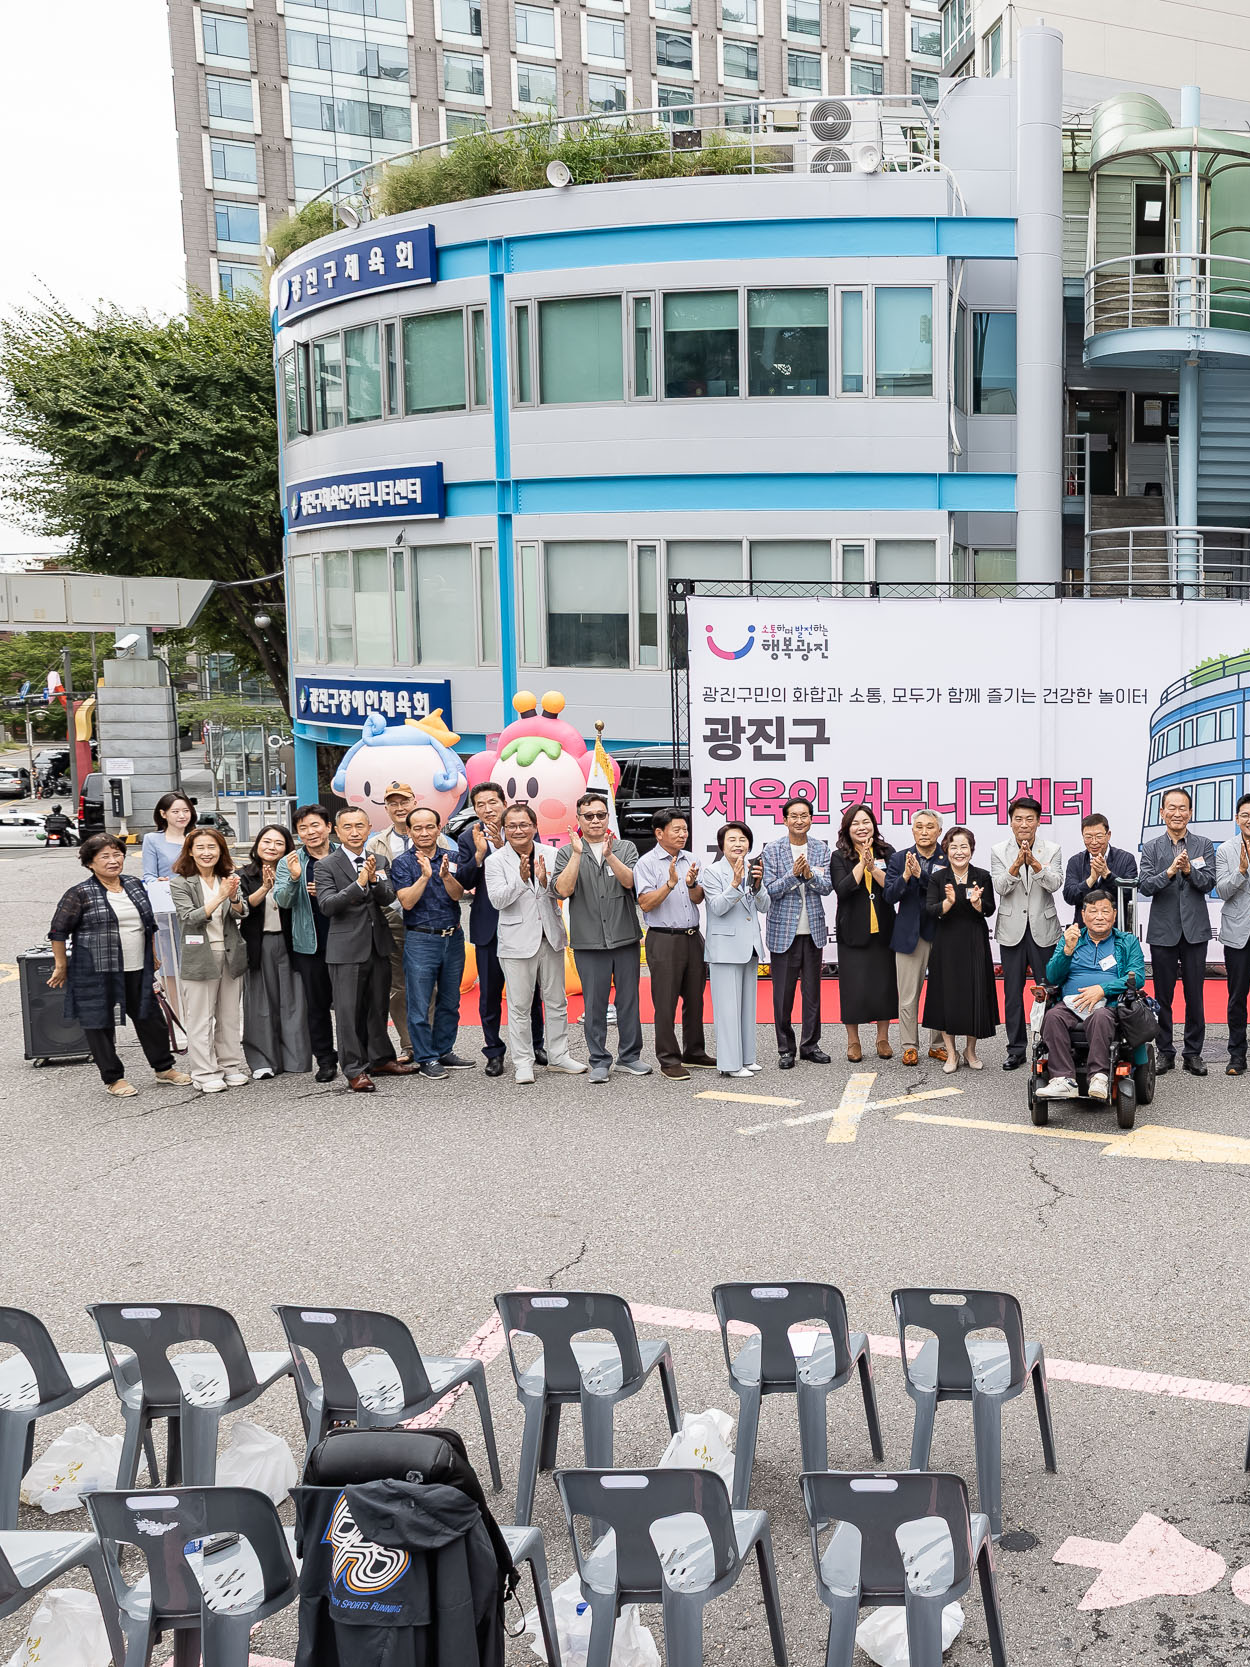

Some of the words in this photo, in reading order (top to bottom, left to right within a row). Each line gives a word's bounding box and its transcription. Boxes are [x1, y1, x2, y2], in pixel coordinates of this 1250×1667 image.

[291, 241, 414, 302] 광진구체육회
[300, 478, 422, 516] 광진구체육인커뮤니티센터
[761, 624, 793, 638] 소통하며
[795, 624, 829, 639] 발전하는
[761, 637, 829, 661] 행복광진
[309, 687, 430, 718] 광진구장애인체육회
[702, 686, 787, 703] 광진구민의
[792, 686, 843, 703] 화합과
[849, 687, 886, 704] 소통,
[892, 687, 942, 703] 모두가
[948, 687, 980, 704] 함께
[987, 687, 1036, 704] 즐기는
[1043, 688, 1092, 704] 건강한
[1098, 688, 1148, 704] 놀이터
[702, 716, 831, 762] 광진구
[702, 777, 830, 825] 체육인
[840, 777, 1093, 825] 커뮤니티센터
[341, 1599, 370, 1610] SPORTS
[370, 1602, 403, 1613] RUNNING
